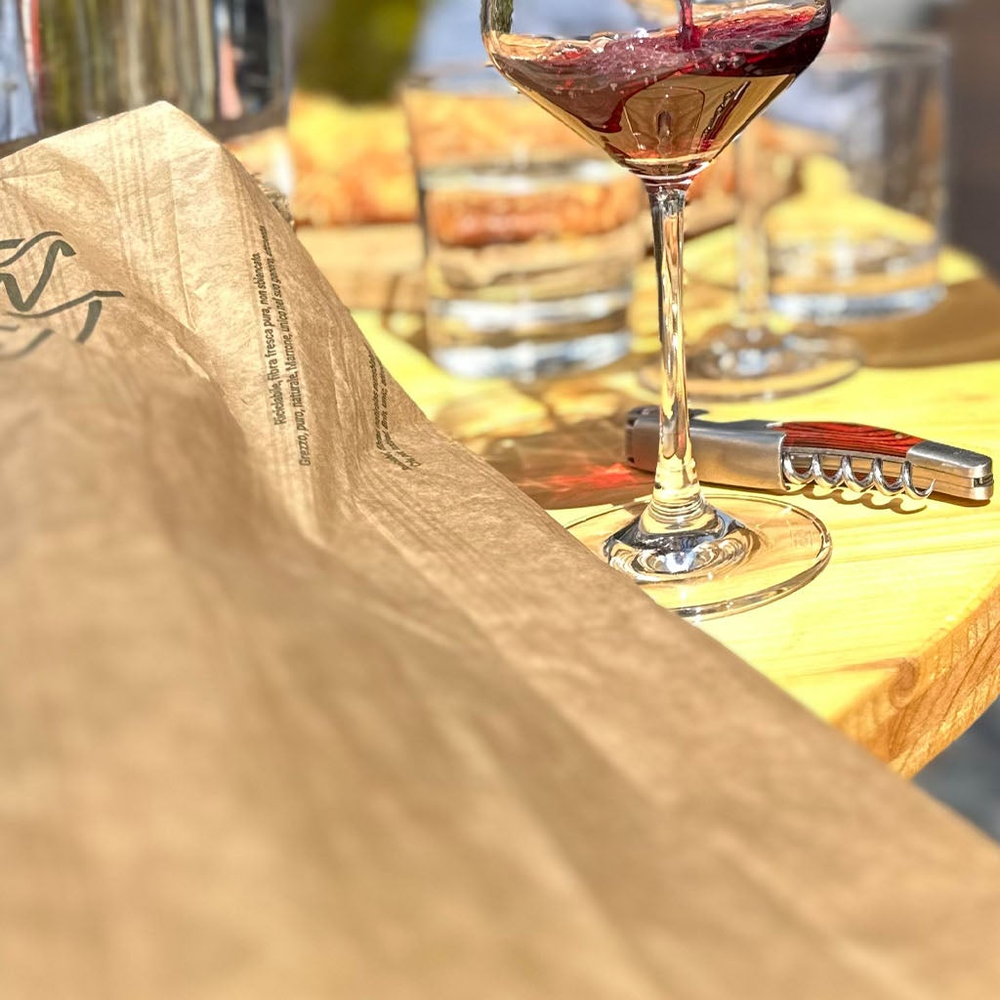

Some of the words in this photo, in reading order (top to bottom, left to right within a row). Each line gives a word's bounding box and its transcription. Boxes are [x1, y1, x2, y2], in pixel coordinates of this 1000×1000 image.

[258, 290, 269, 305] non
[272, 283, 282, 297] suo
[261, 306, 276, 327] pura,
[276, 310, 290, 332] unico
[264, 328, 276, 358] fresca
[267, 359, 280, 381] fibra
[294, 409, 307, 431] puro,
[298, 430, 311, 466] Grezzo,
